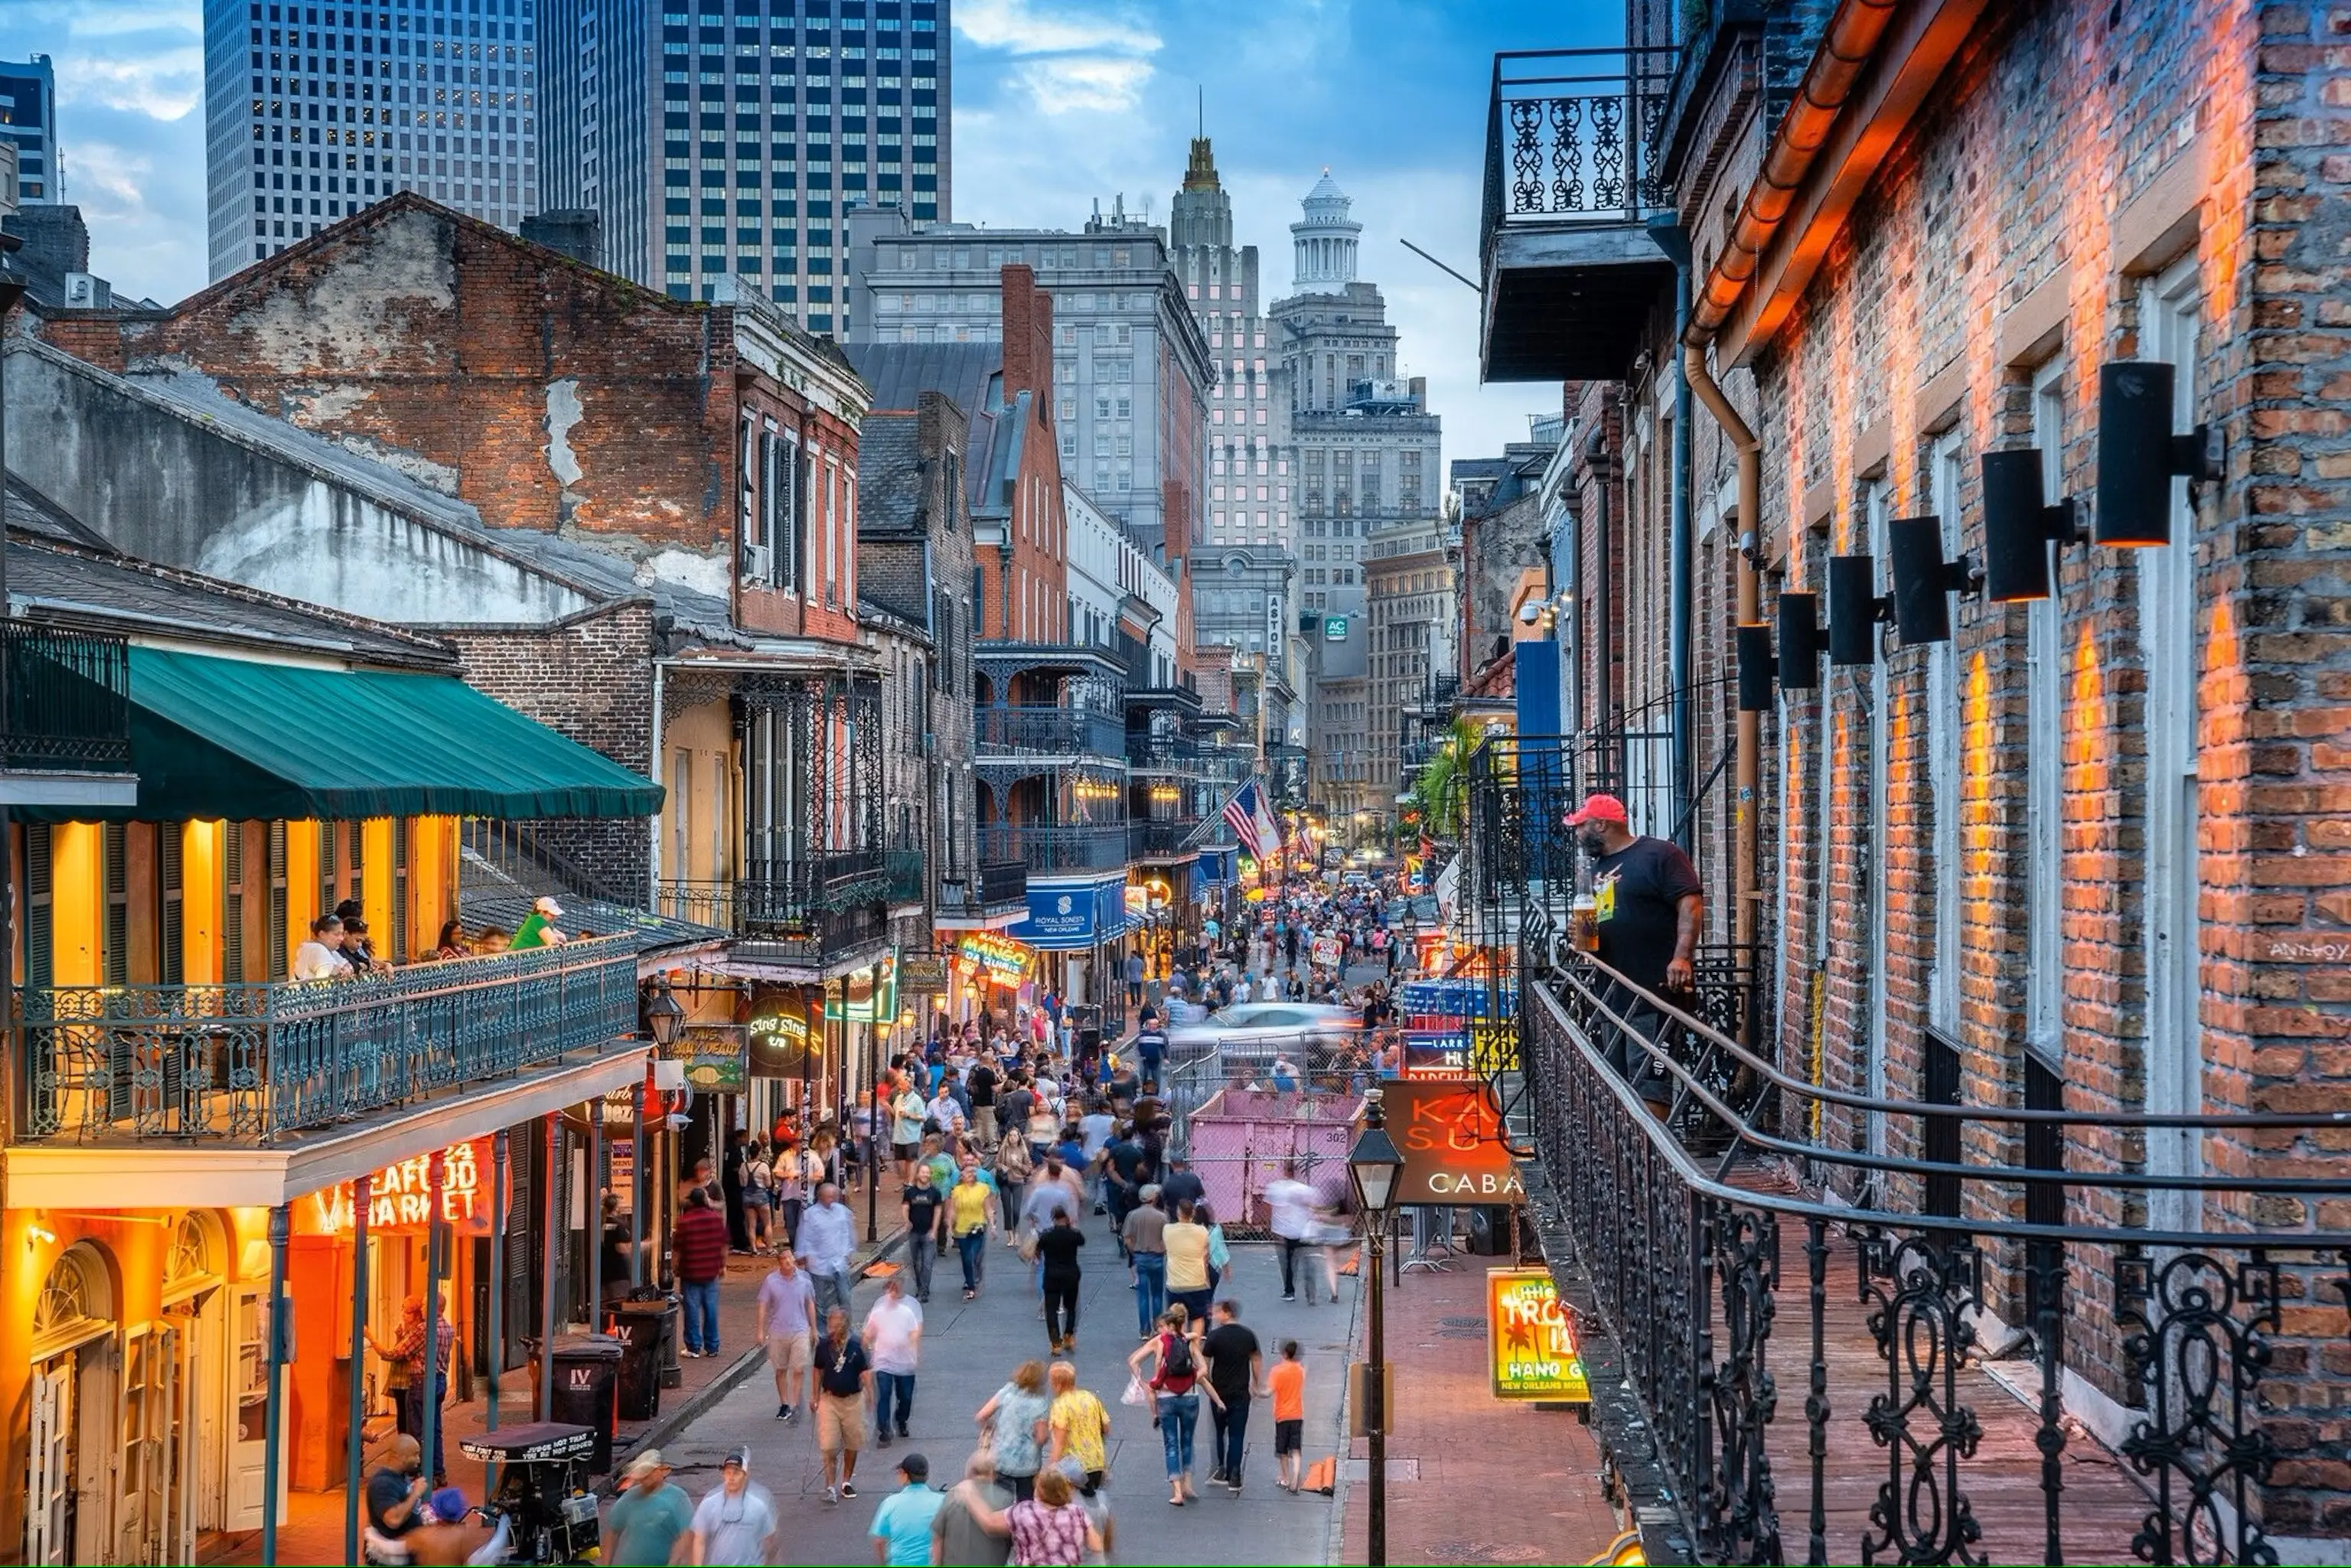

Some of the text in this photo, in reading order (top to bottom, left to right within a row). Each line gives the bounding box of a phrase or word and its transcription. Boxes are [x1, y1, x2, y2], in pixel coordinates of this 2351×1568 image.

[1329, 621, 1345, 631] AC
[978, 931, 1016, 949] MANGO
[964, 937, 1026, 965] MANGO
[902, 968, 941, 978] MANGO
[749, 1018, 806, 1038] Sing Sing
[1433, 1039, 1472, 1048] LARR
[1326, 1133, 1346, 1143] 302
[1405, 1127, 1497, 1152] SU
[347, 1159, 478, 1198] EAFOOD
[1428, 1172, 1524, 1194] CABA
[570, 1369, 591, 1384] IV
[1508, 1362, 1560, 1378] HAND
[1502, 1381, 1521, 1390] NEW
[1522, 1381, 1562, 1390] ORLEANS
[523, 1452, 536, 1460] YOU
[552, 1447, 566, 1456] NOT
[568, 1440, 594, 1452] JUDGED
[527, 1433, 587, 1453] JUDGE NOT THAT
